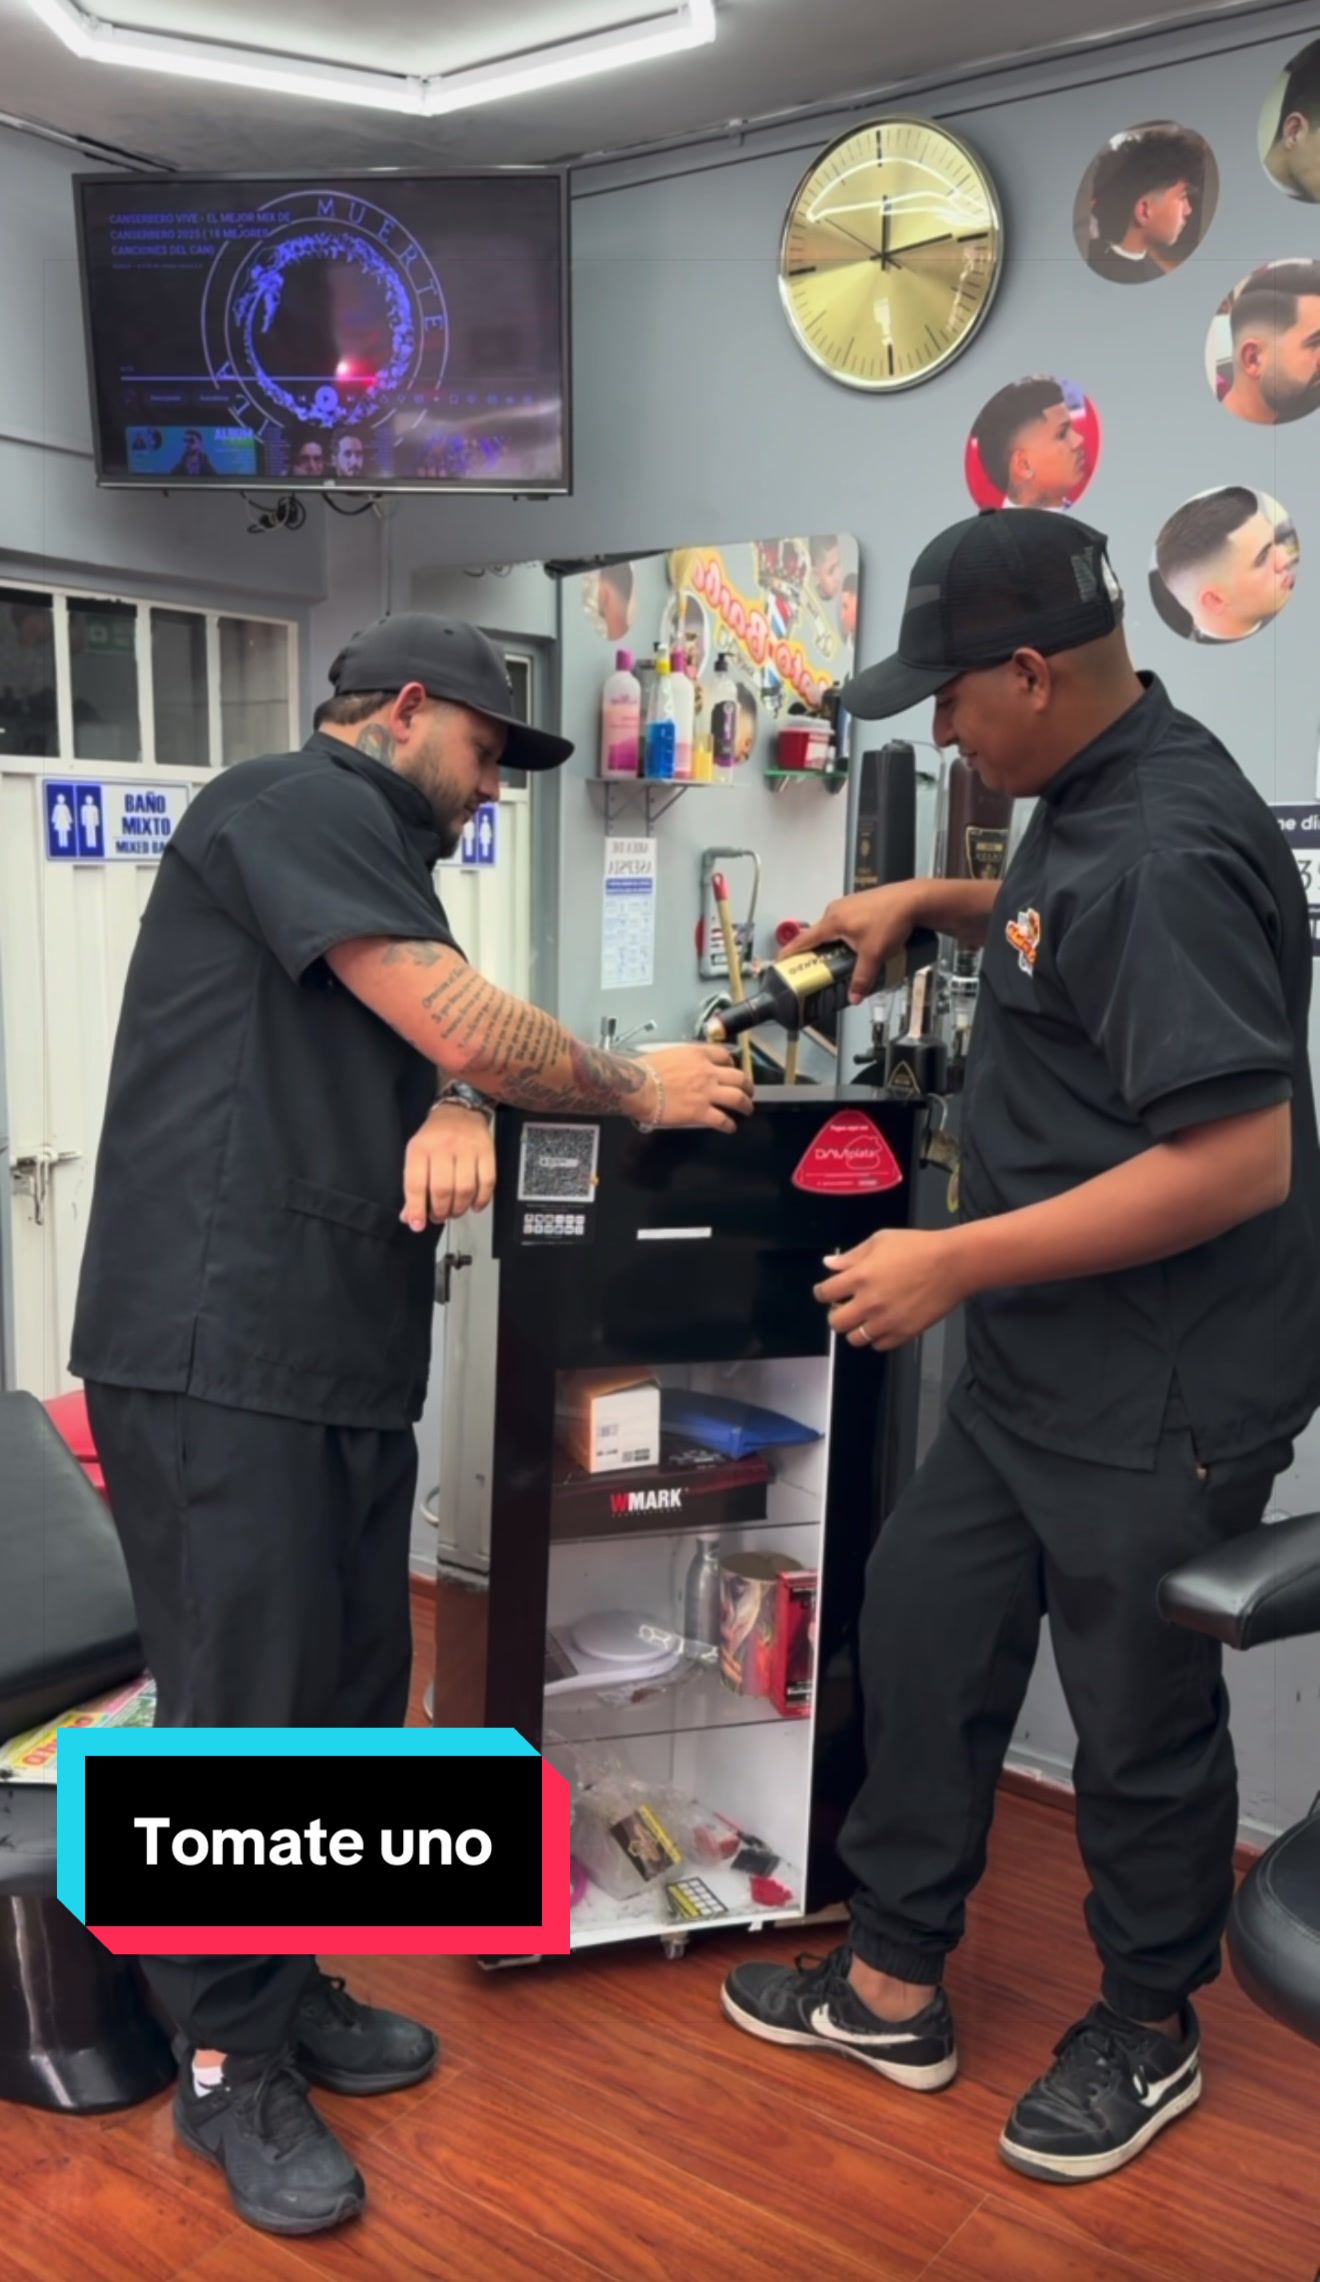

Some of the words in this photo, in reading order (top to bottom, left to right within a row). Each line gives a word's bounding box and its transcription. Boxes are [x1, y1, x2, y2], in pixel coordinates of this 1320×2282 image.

[220, 211, 255, 223] MEJOR
[316, 196, 443, 332] MUERTE
[124, 791, 166, 814] BAÑO
[121, 816, 171, 836] MIXTO
[115, 841, 149, 854] MIXED
[610, 1486, 682, 1514] WMARK
